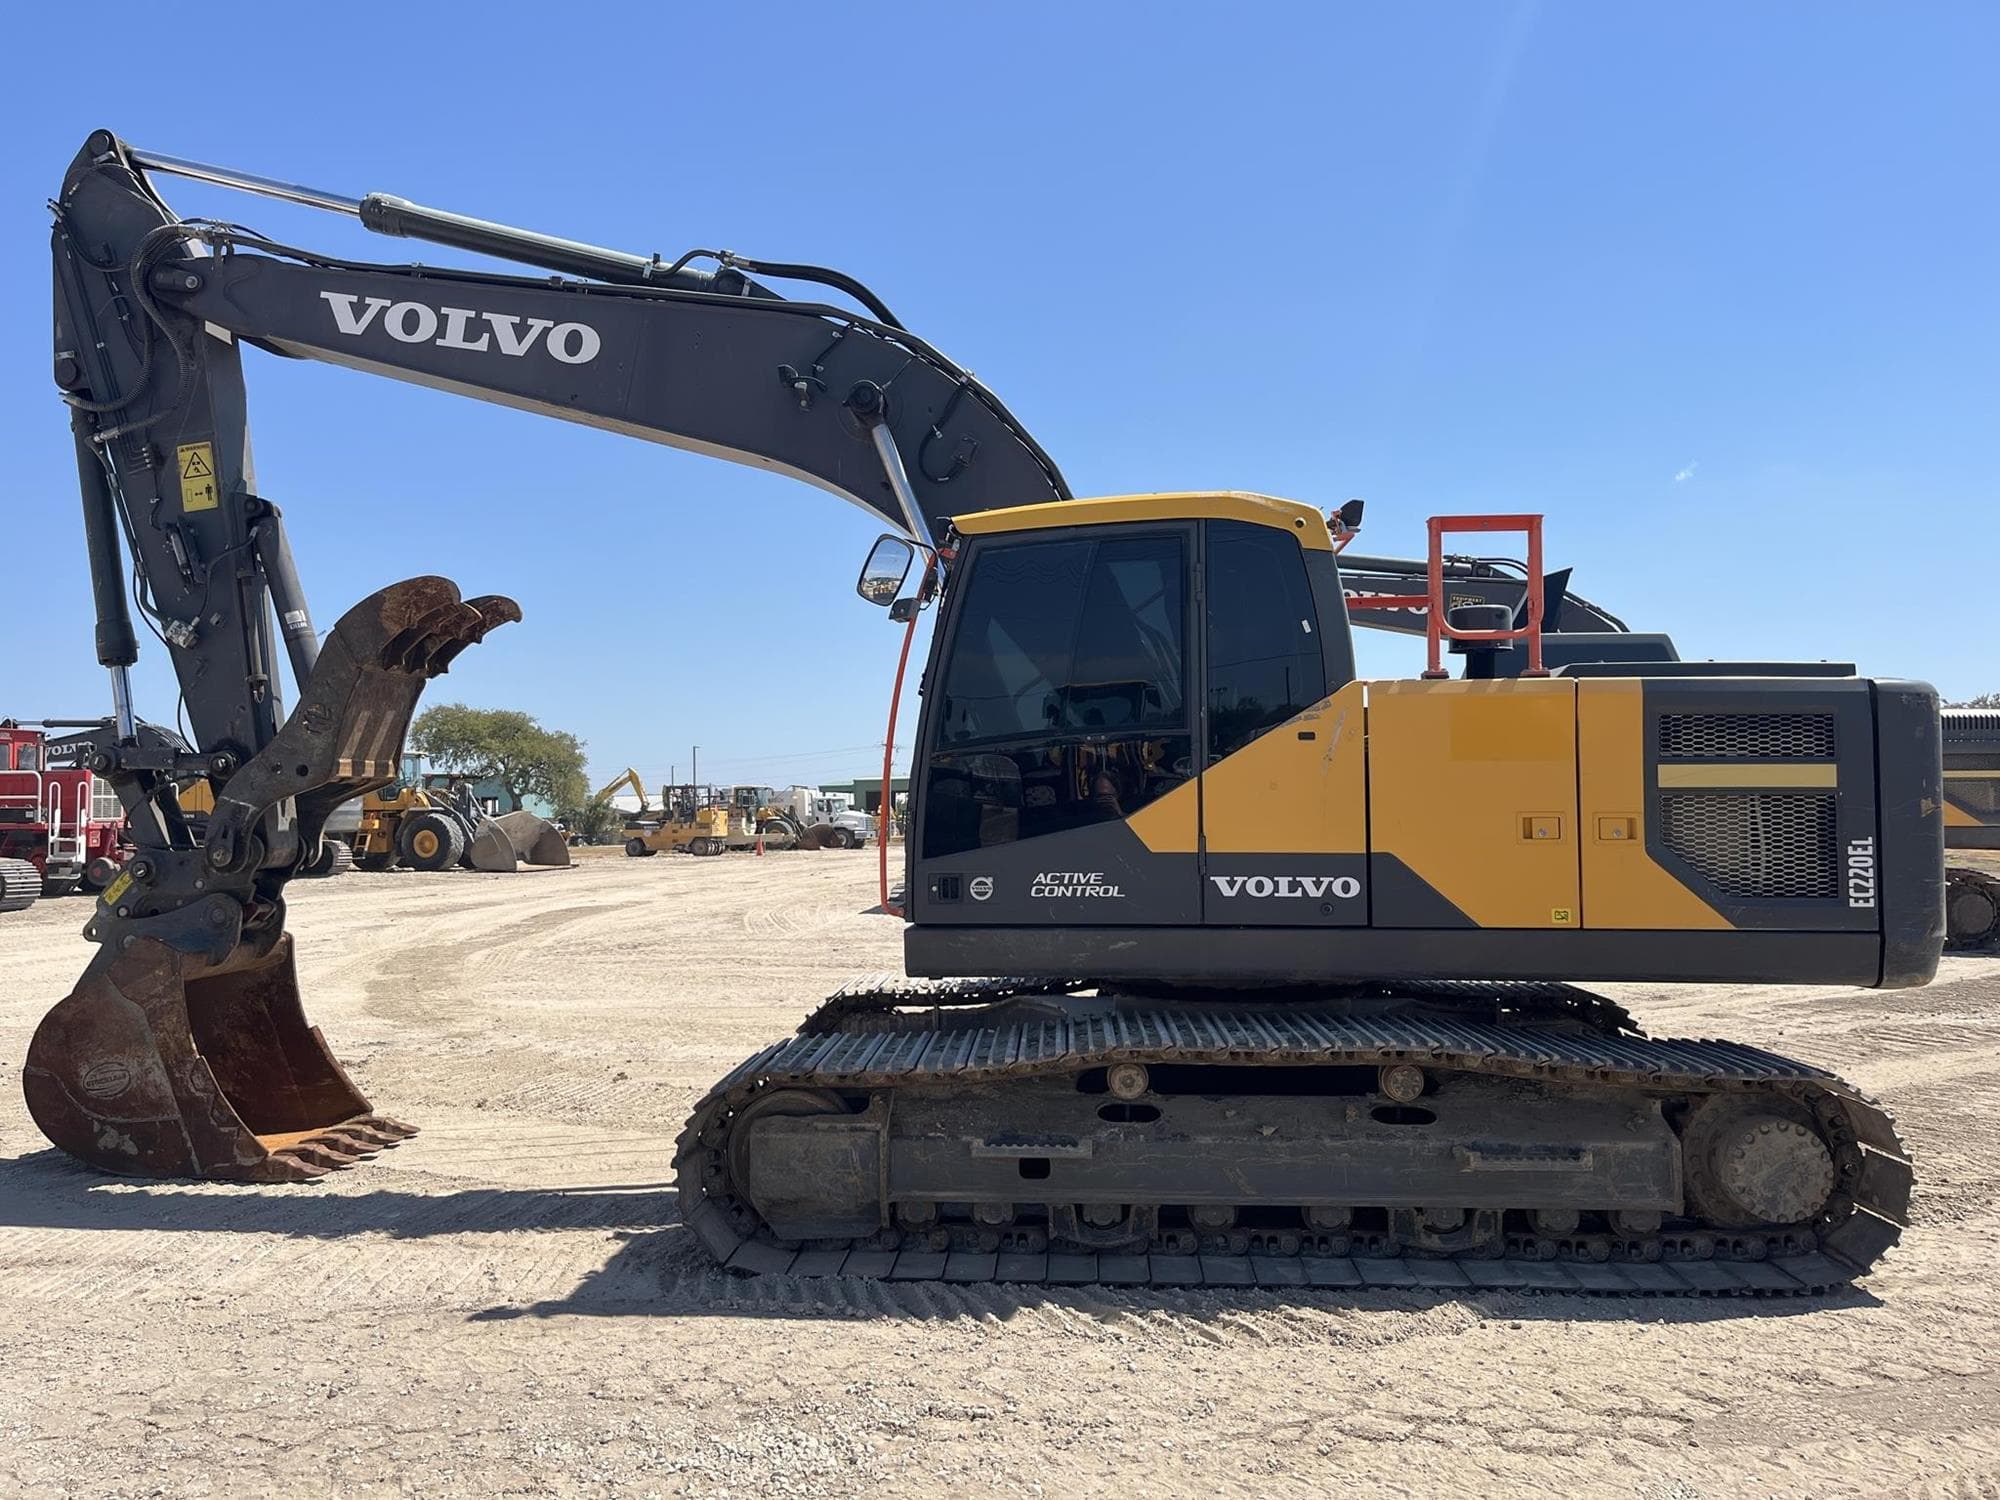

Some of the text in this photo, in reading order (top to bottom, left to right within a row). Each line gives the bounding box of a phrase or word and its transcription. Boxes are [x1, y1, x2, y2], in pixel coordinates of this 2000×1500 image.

[320, 291, 600, 364] VOLVO
[47, 742, 93, 756] OLV
[1033, 872, 1104, 884] ACTIVE
[1848, 836, 1875, 907] EC220EL
[1031, 885, 1125, 897] CONTROL
[1210, 876, 1361, 898] VOLVO
